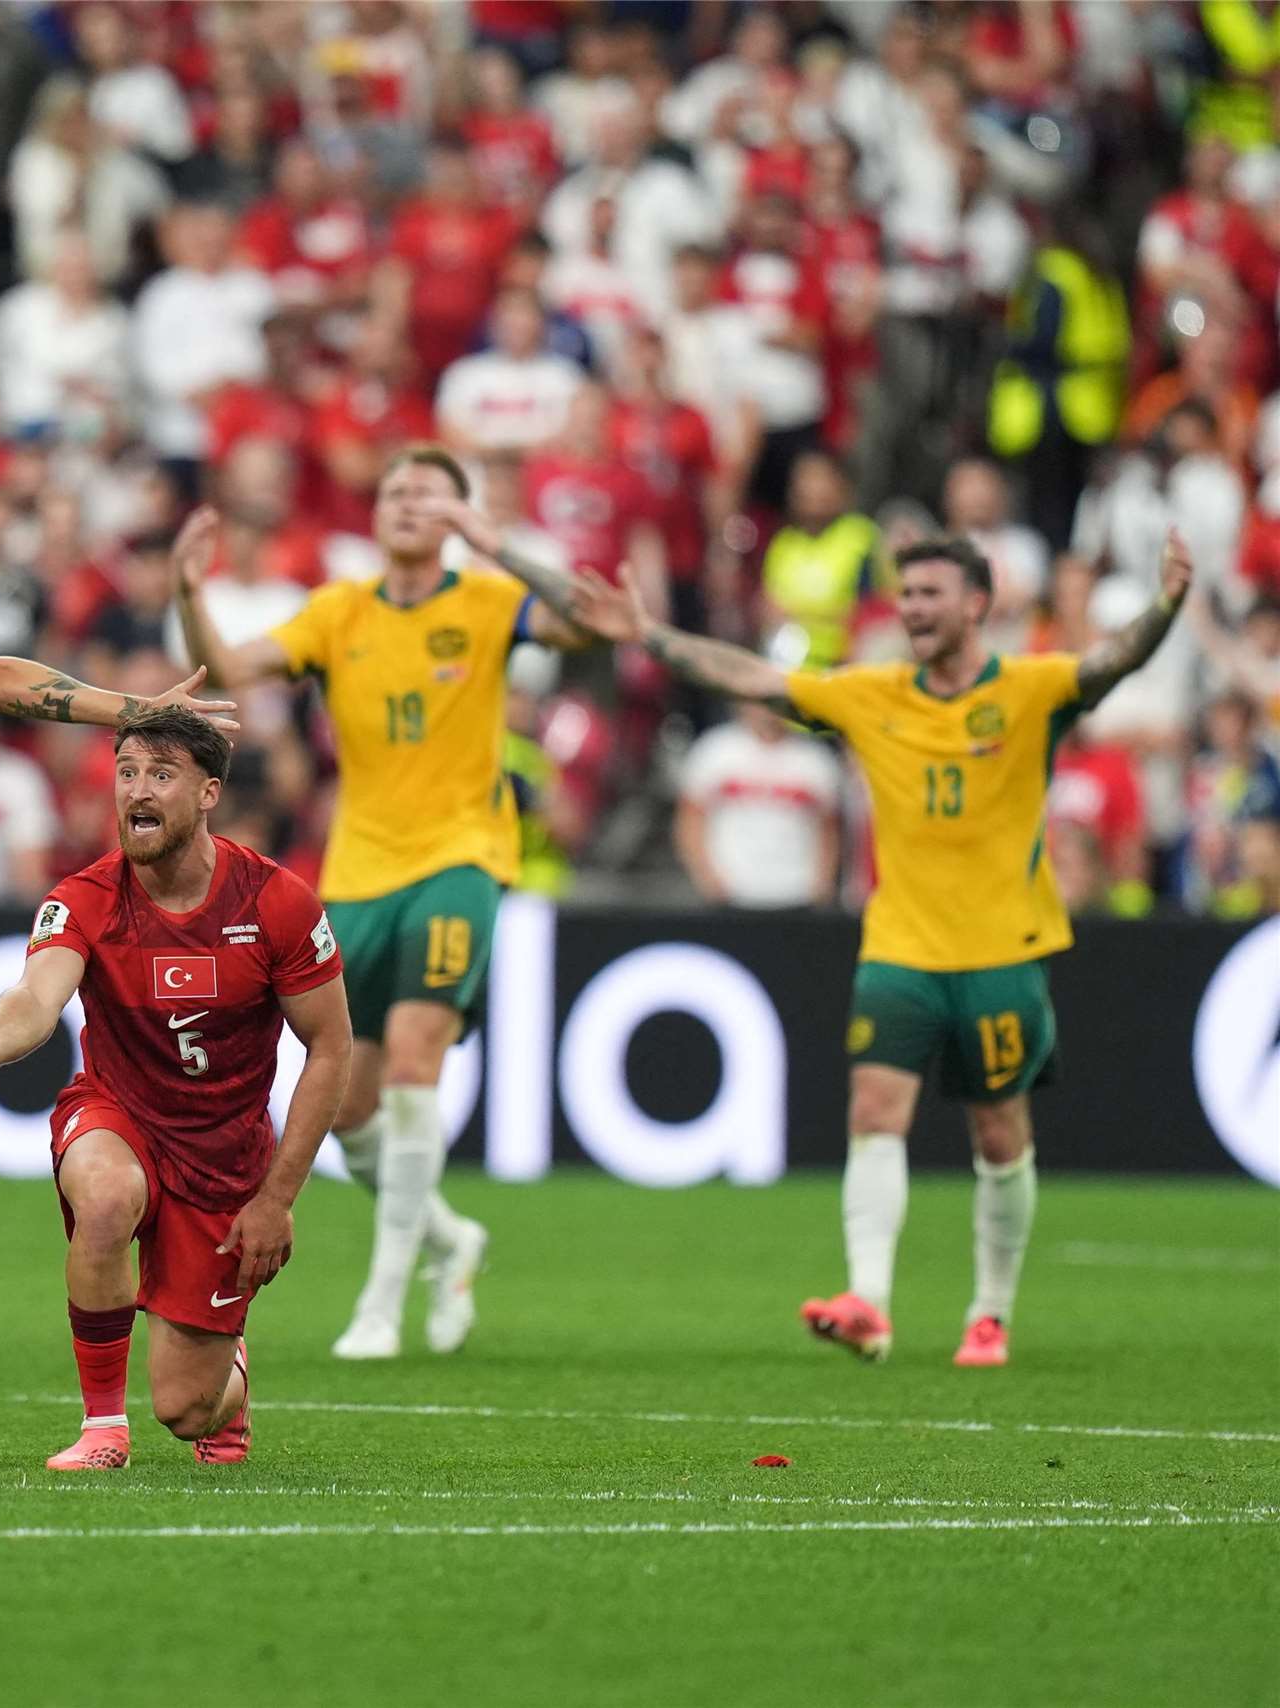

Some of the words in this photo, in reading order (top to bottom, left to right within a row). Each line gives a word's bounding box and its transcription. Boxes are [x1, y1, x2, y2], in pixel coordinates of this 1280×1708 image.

[384, 691, 427, 744] 19
[924, 765, 965, 818] 13
[427, 915, 471, 977] 19
[177, 1031, 209, 1076] 5
[978, 1010, 1025, 1074] 13
